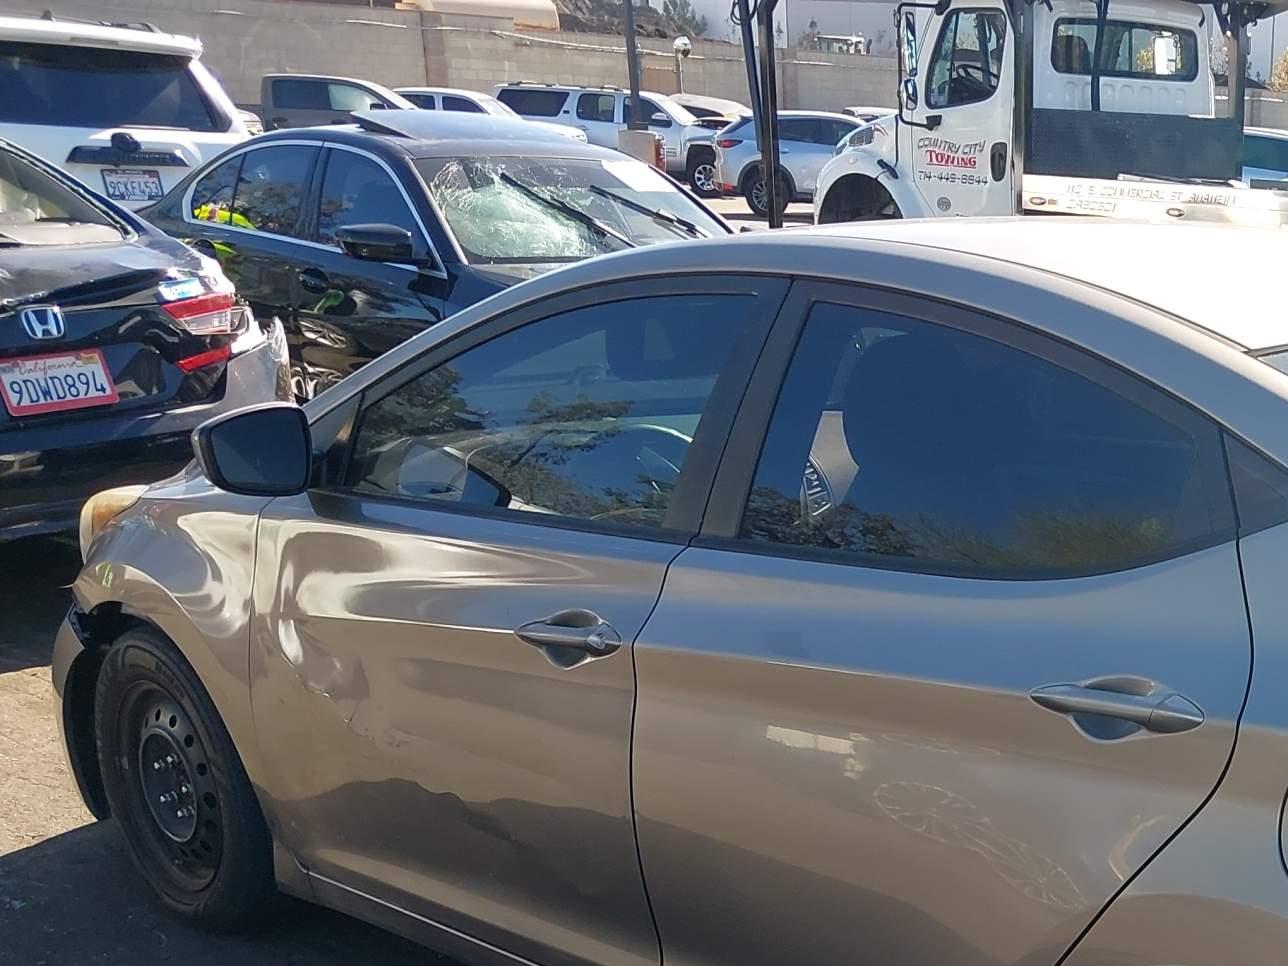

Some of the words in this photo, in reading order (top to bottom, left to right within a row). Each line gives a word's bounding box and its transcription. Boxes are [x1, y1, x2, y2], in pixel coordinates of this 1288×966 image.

[917, 137, 961, 154] COUNTRY
[962, 140, 986, 155] CITY
[925, 150, 977, 167] TOWING
[109, 180, 160, 196] 9CKF453
[10, 370, 107, 406] 9DWD894
